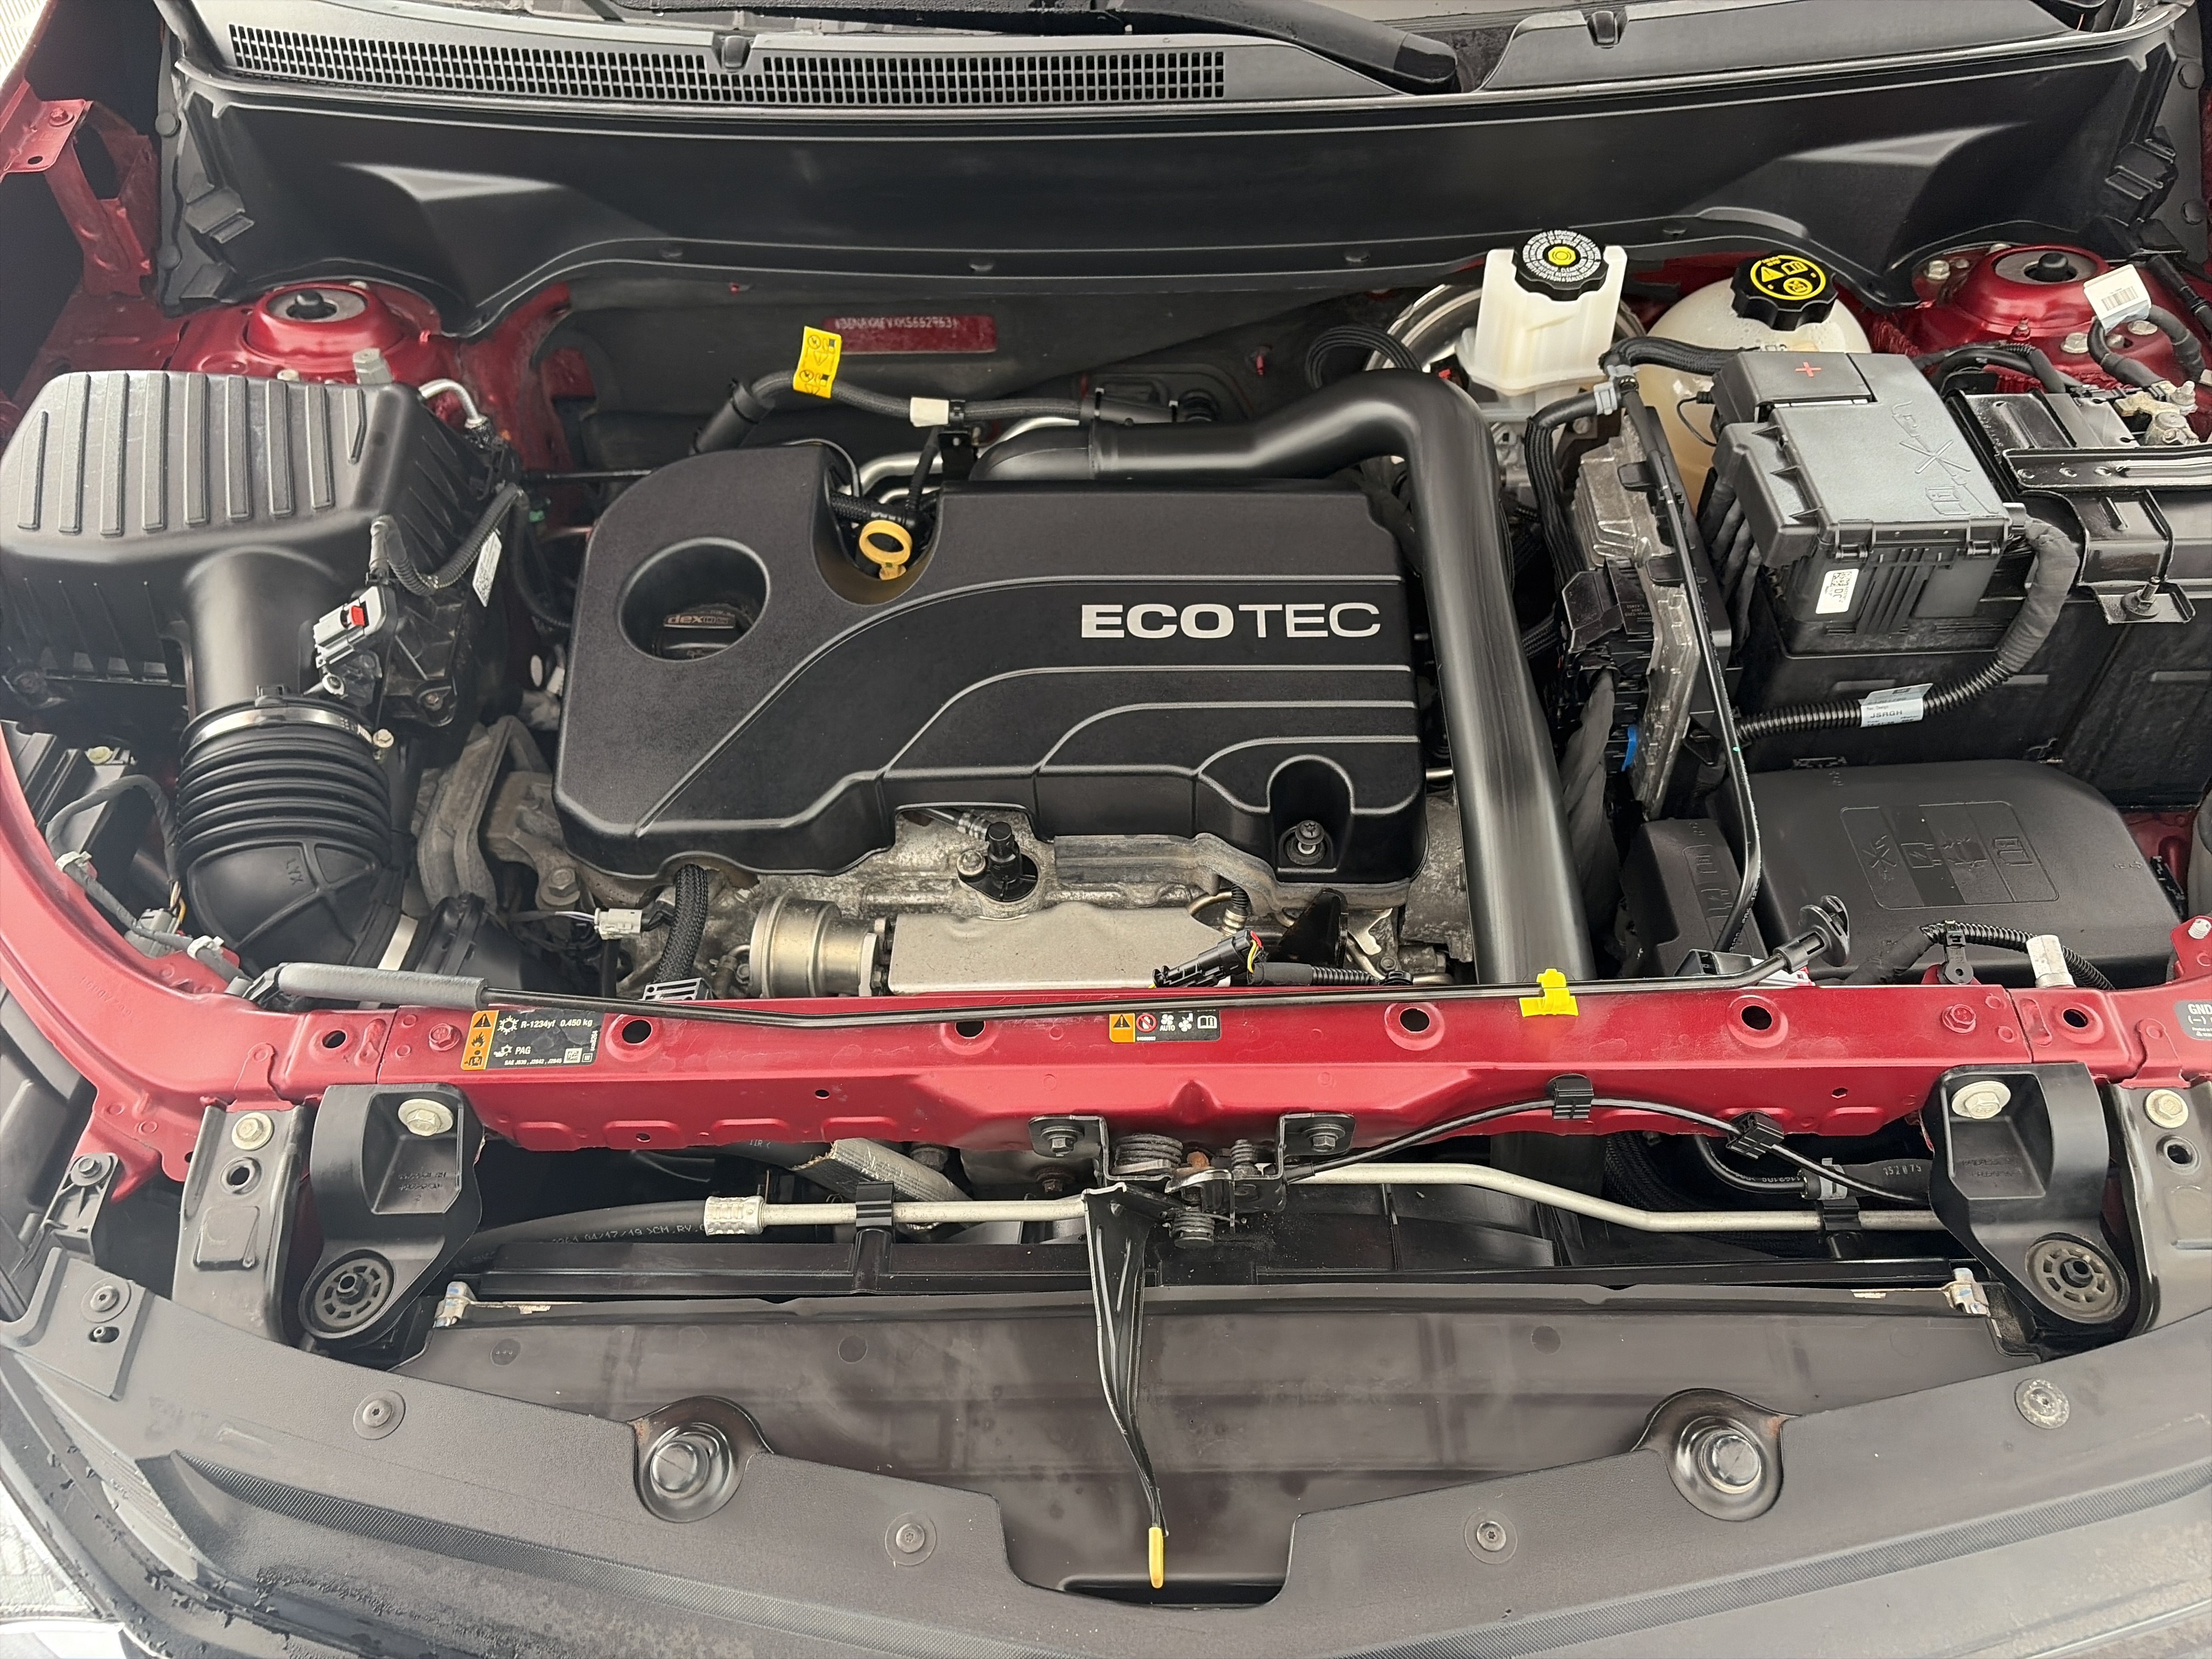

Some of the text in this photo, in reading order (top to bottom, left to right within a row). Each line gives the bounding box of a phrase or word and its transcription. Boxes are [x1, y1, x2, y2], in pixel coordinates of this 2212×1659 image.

[1081, 602, 1381, 639] ECOTEC
[521, 1018, 593, 1029] R-1234yf 0.450 kg
[515, 1046, 531, 1054] PAG
